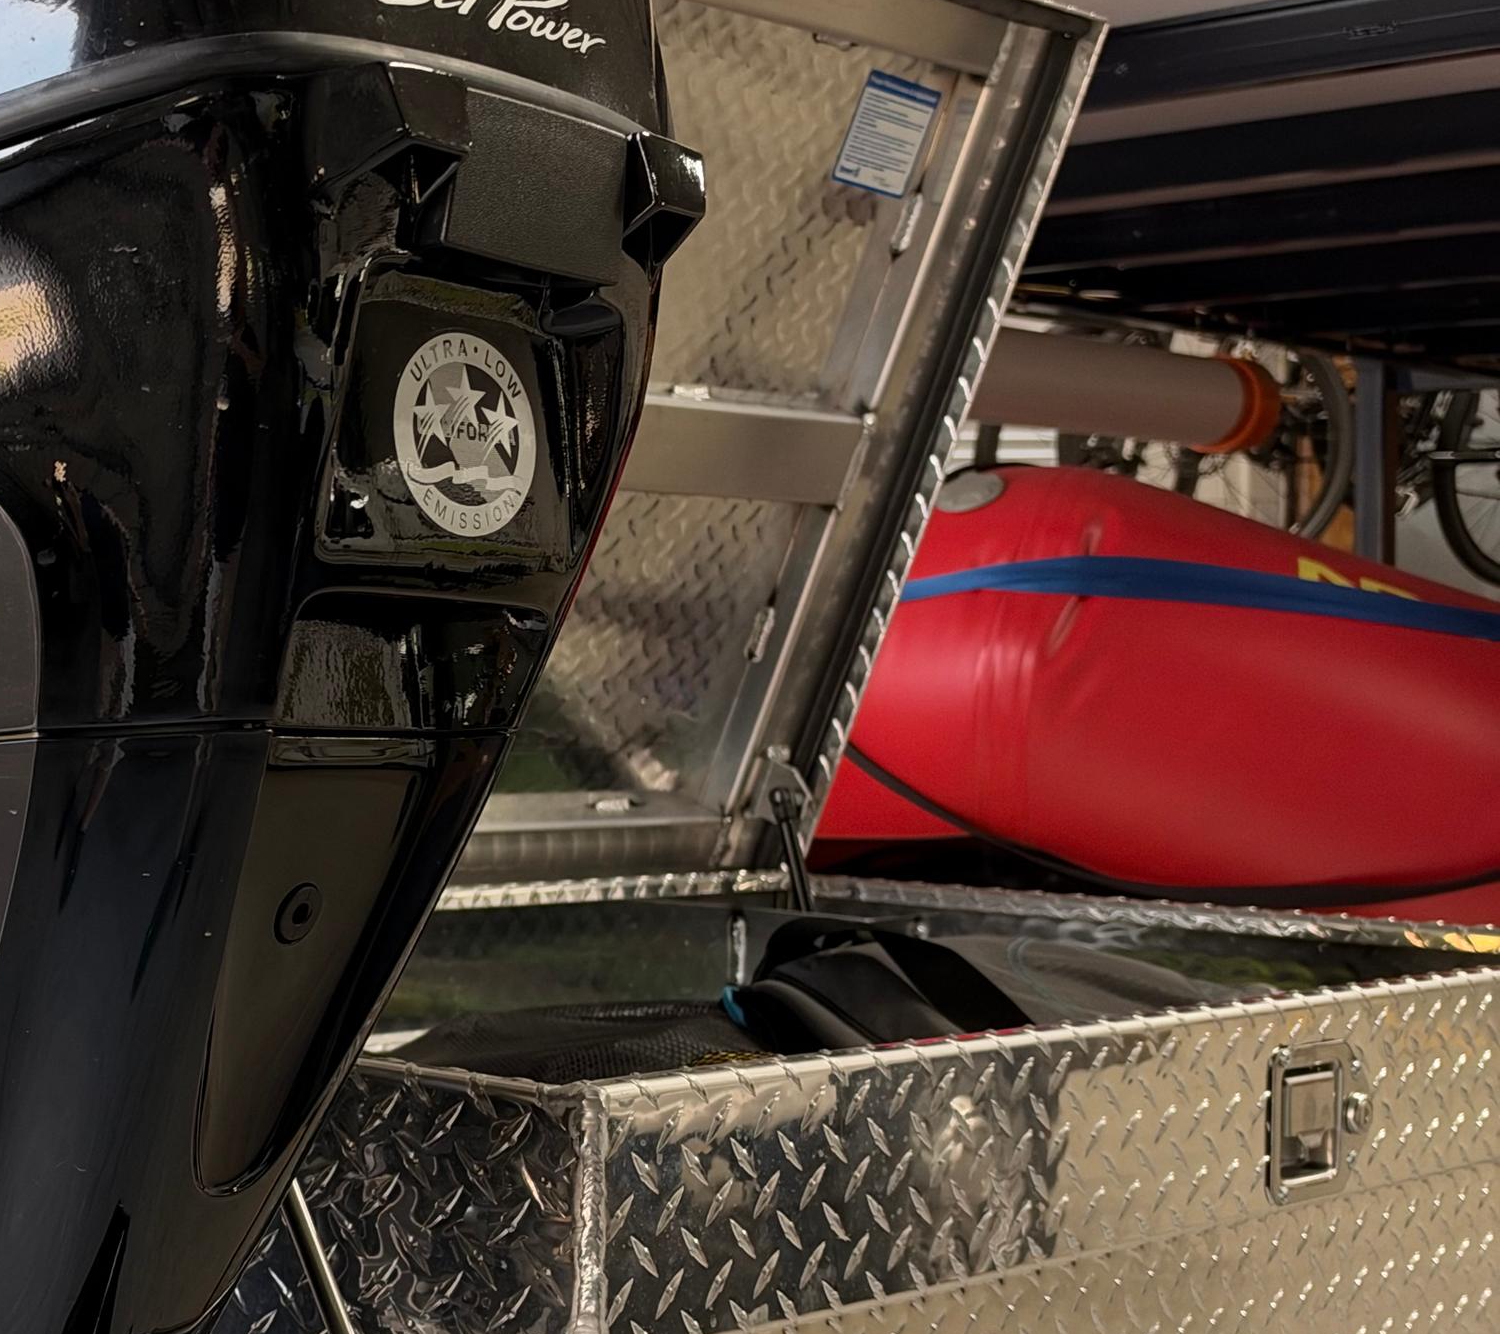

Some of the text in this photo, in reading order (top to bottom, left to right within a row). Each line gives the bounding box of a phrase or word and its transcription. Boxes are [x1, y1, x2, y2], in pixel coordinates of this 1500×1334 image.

[409, 338, 523, 399] ULTRA LOW
[422, 488, 515, 530] EMISSION
